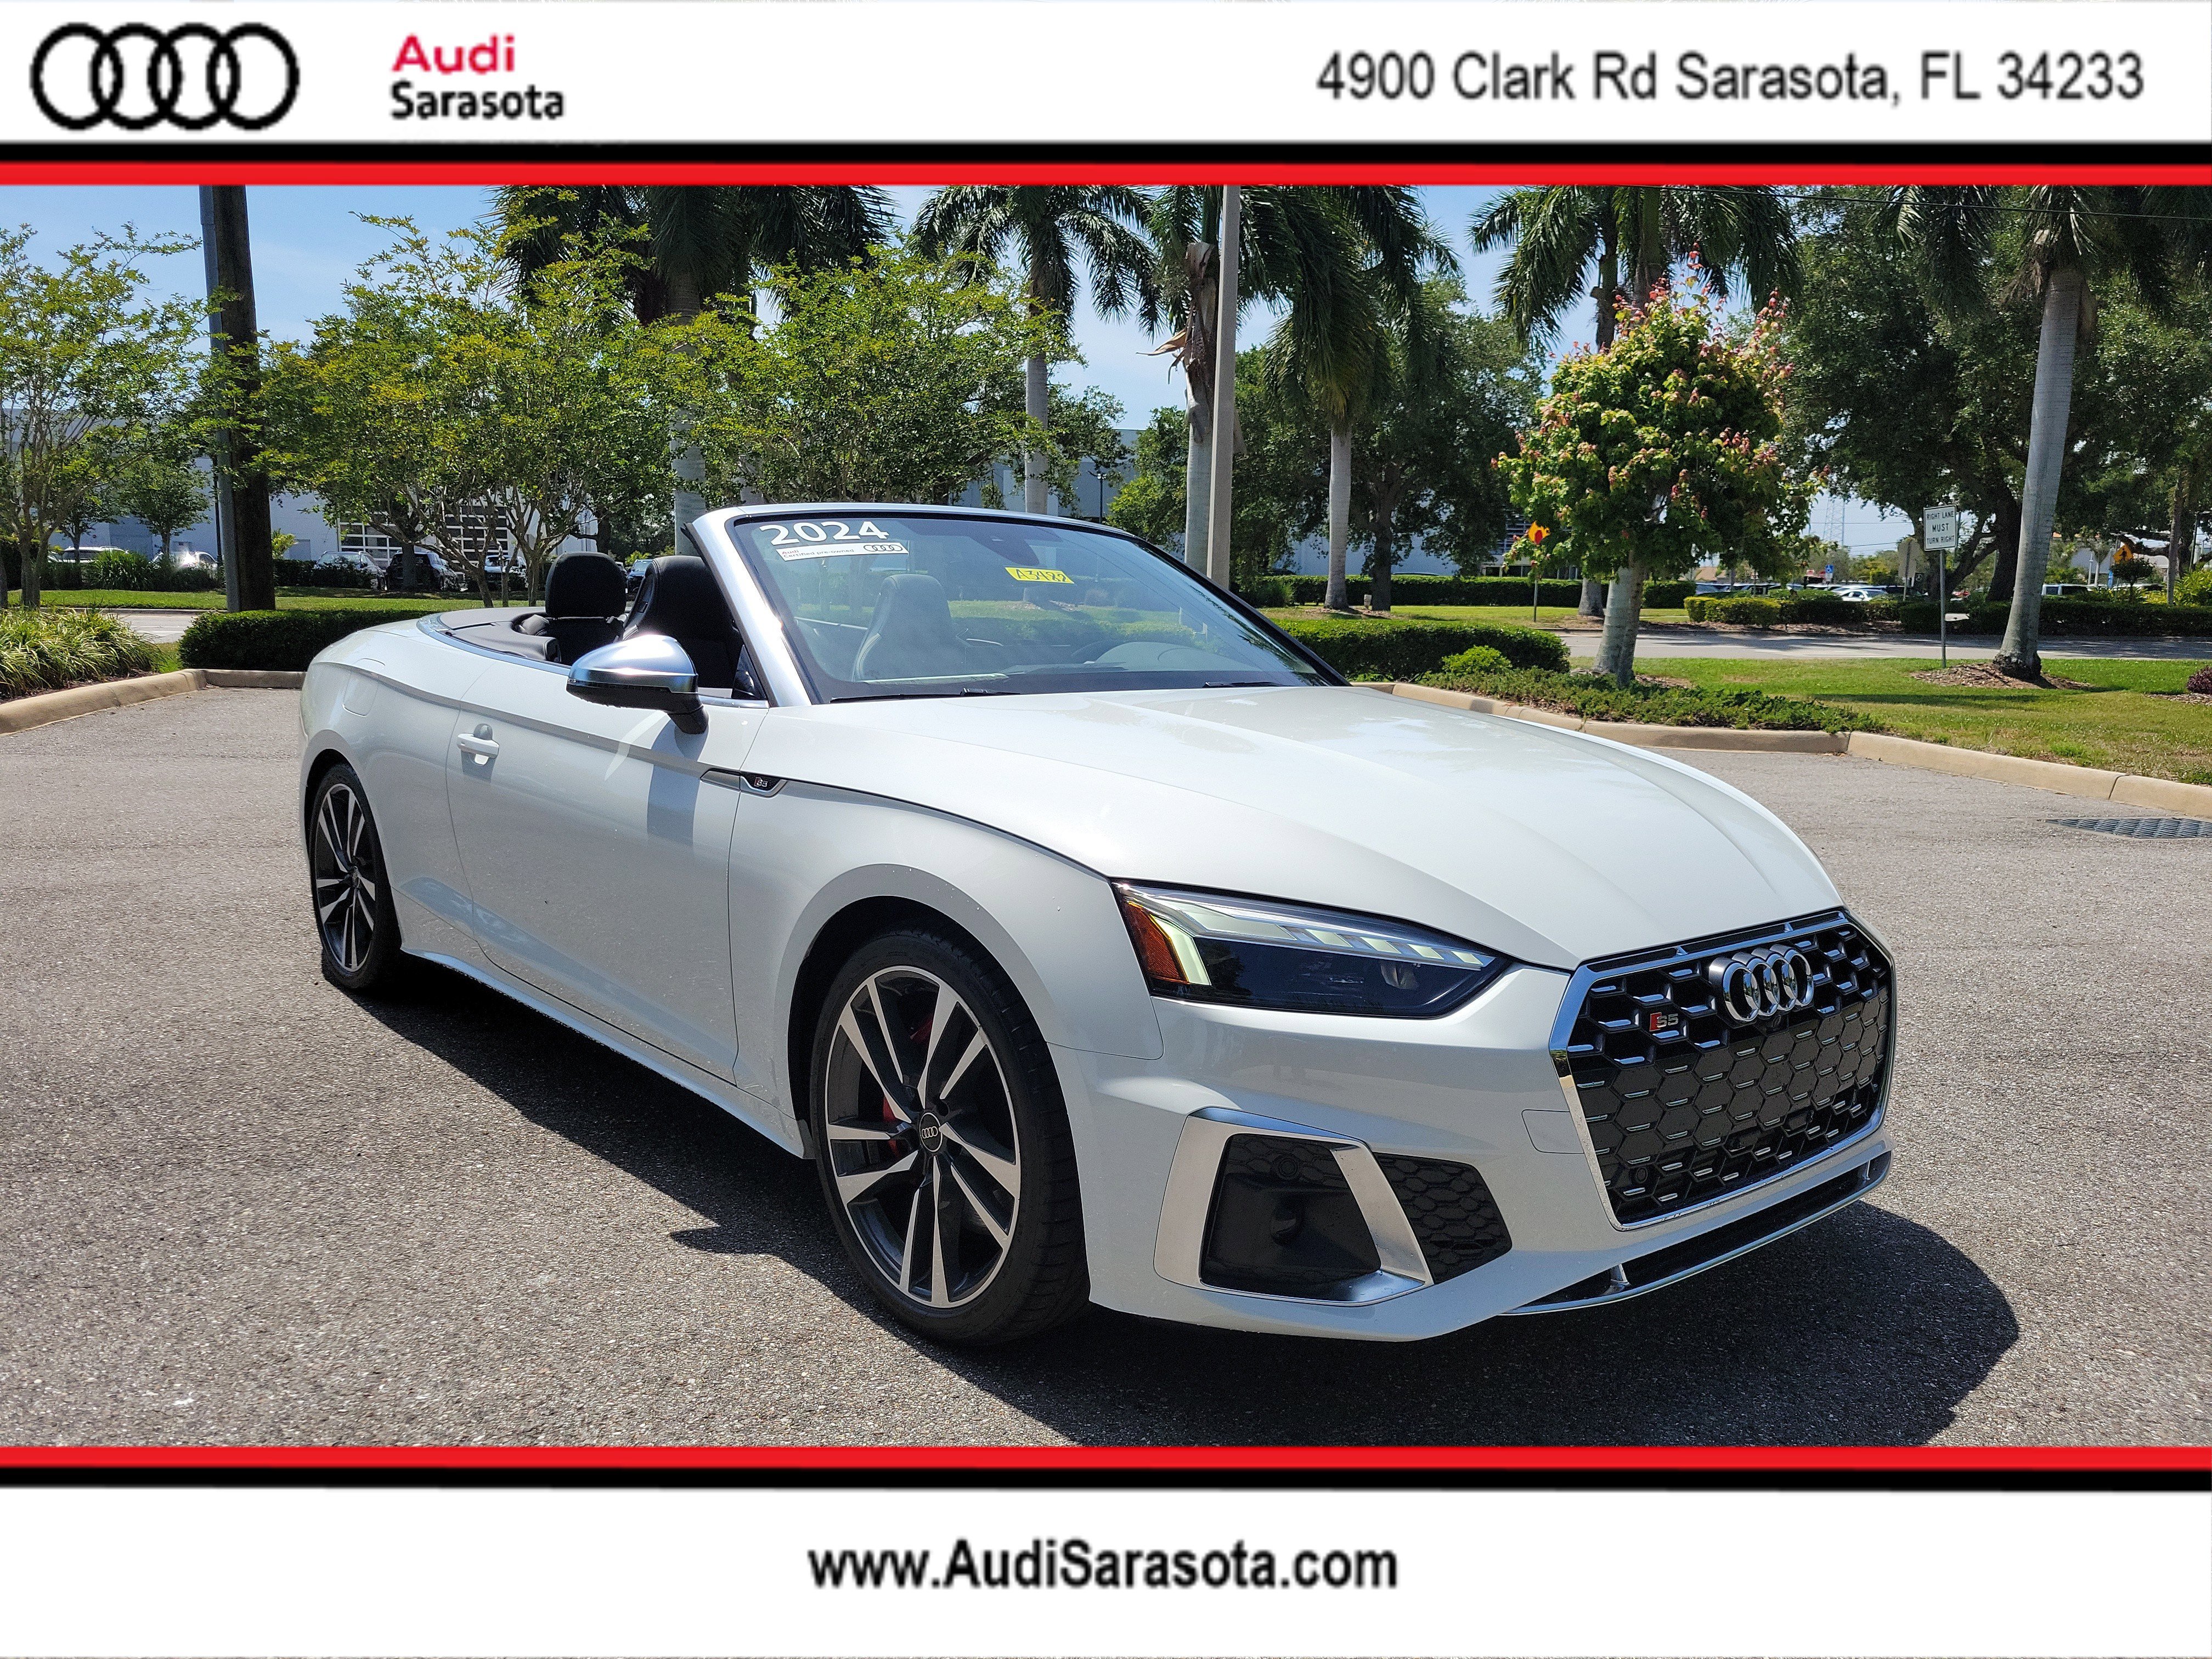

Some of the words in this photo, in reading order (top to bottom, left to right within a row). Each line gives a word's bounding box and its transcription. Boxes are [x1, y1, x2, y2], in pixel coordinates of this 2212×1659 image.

[759, 521, 890, 546] 2024
[1932, 523, 1949, 532] MUST
[1015, 569, 1066, 582] A3482
[1656, 1013, 1679, 1028] S5
